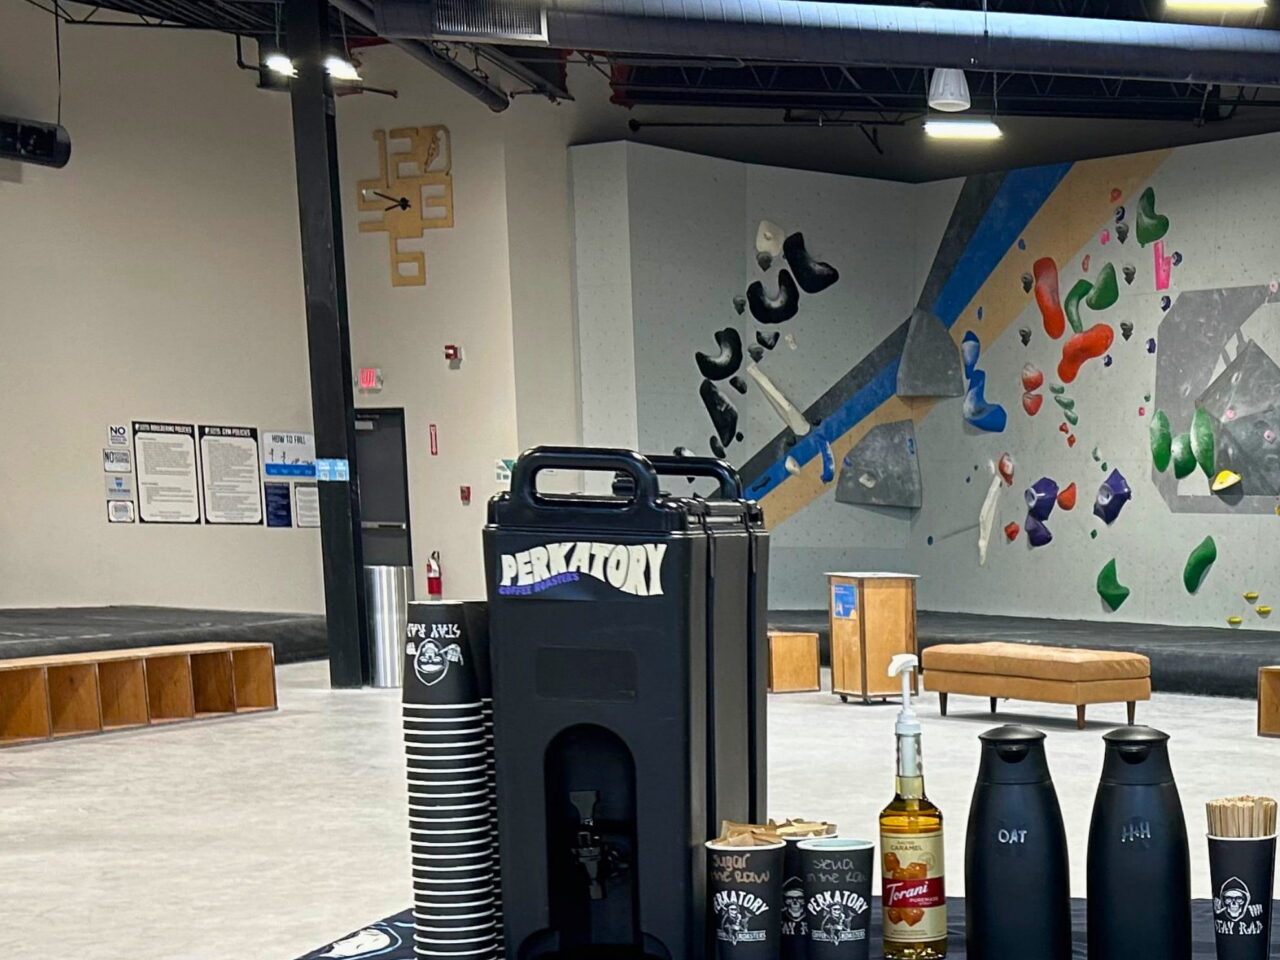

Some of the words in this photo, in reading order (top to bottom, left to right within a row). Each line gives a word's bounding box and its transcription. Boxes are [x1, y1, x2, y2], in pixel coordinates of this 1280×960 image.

[110, 426, 126, 435] NO
[271, 434, 285, 444] HOW
[286, 435, 293, 444] TO
[294, 436, 306, 446] FALL
[500, 541, 667, 596] PERKATORY
[430, 623, 461, 639] STAY
[998, 828, 1028, 844] OAT
[886, 880, 929, 906] Torani
[807, 890, 869, 917] PERKATORY
[1239, 920, 1264, 935] RAD
